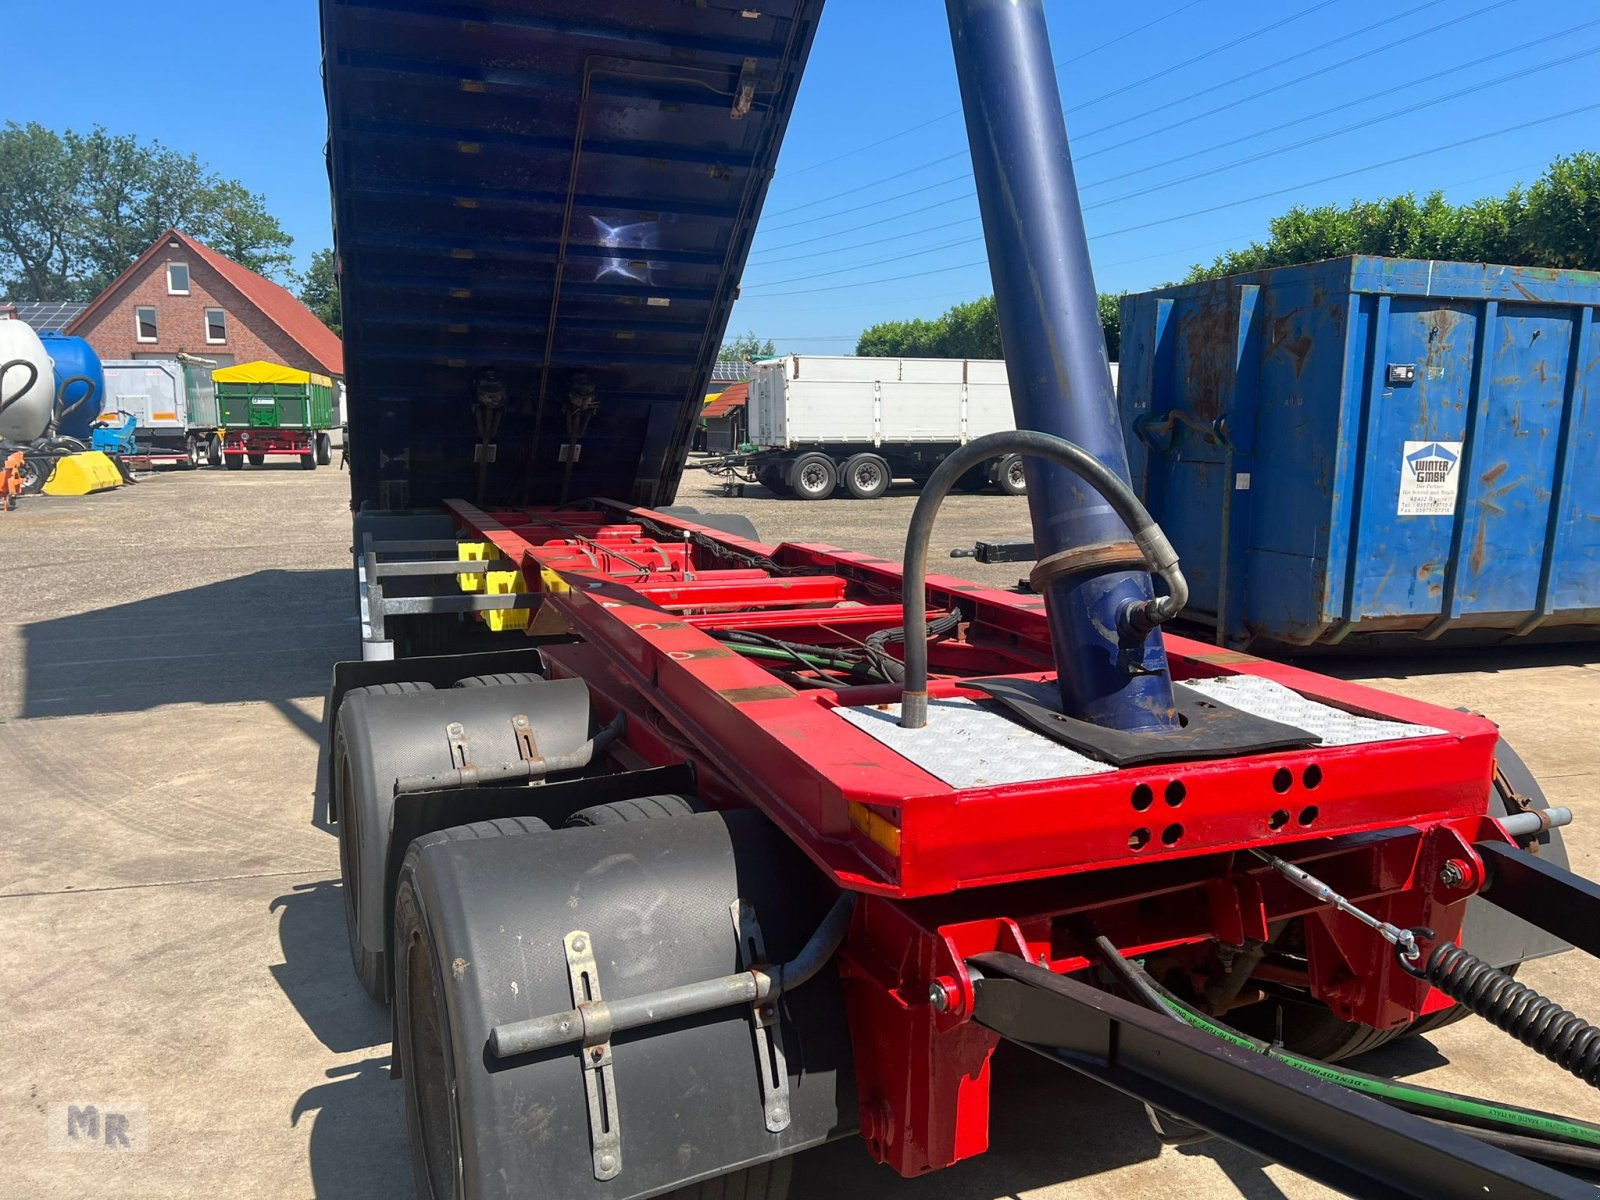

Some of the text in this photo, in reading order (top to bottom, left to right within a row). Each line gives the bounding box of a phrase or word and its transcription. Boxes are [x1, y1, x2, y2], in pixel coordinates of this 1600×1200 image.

[1415, 460, 1449, 471] WINTER
[1416, 472, 1446, 482] GMBH
[1319, 1071, 1362, 1086] DUNLOP
